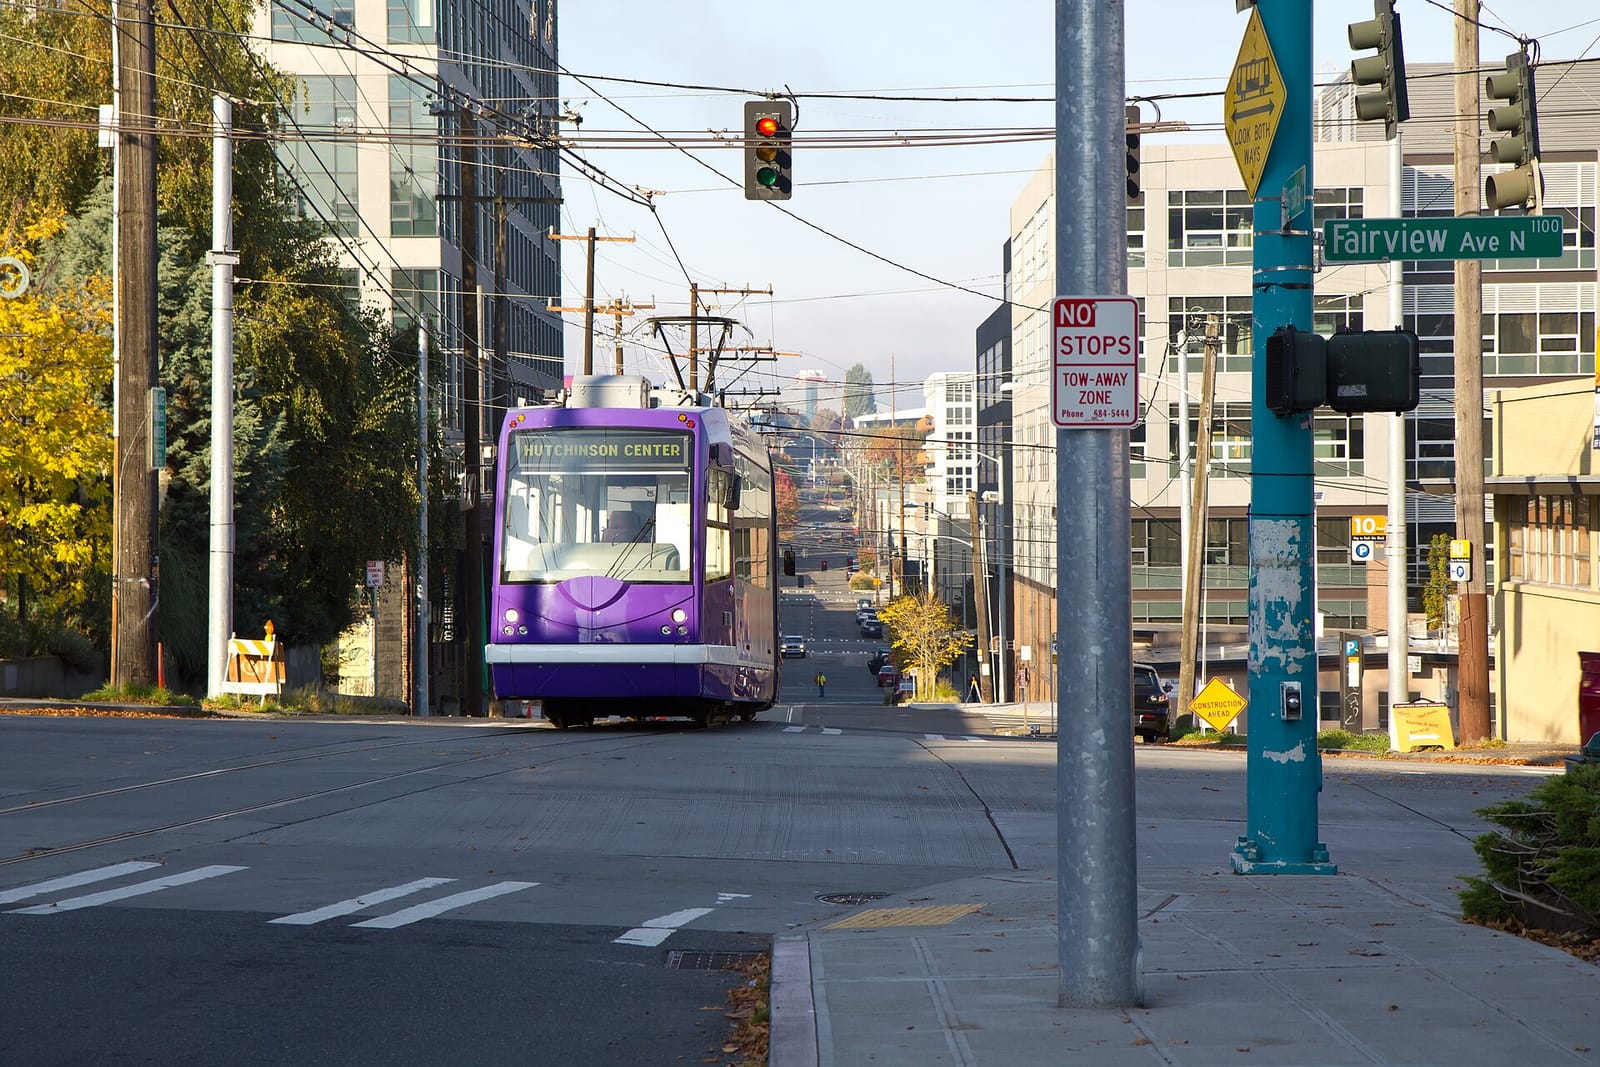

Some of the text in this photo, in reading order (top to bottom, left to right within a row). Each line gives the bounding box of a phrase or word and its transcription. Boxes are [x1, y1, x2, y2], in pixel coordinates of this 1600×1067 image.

[1234, 122, 1270, 145] LOOK BOTH
[1243, 146, 1260, 165] WAYS
[1333, 219, 1560, 255] Fairview Ave N 1100
[1060, 303, 1092, 324] NO
[1060, 335, 1131, 355] STOPS
[1063, 372, 1128, 387] TOW-AWAY
[1079, 390, 1112, 405] ZONE
[1062, 409, 1084, 418] Phone
[524, 444, 680, 457] HUTCHINSON CENTER
[1354, 517, 1376, 533] 10
[1193, 700, 1242, 709] CONSTRUCTION
